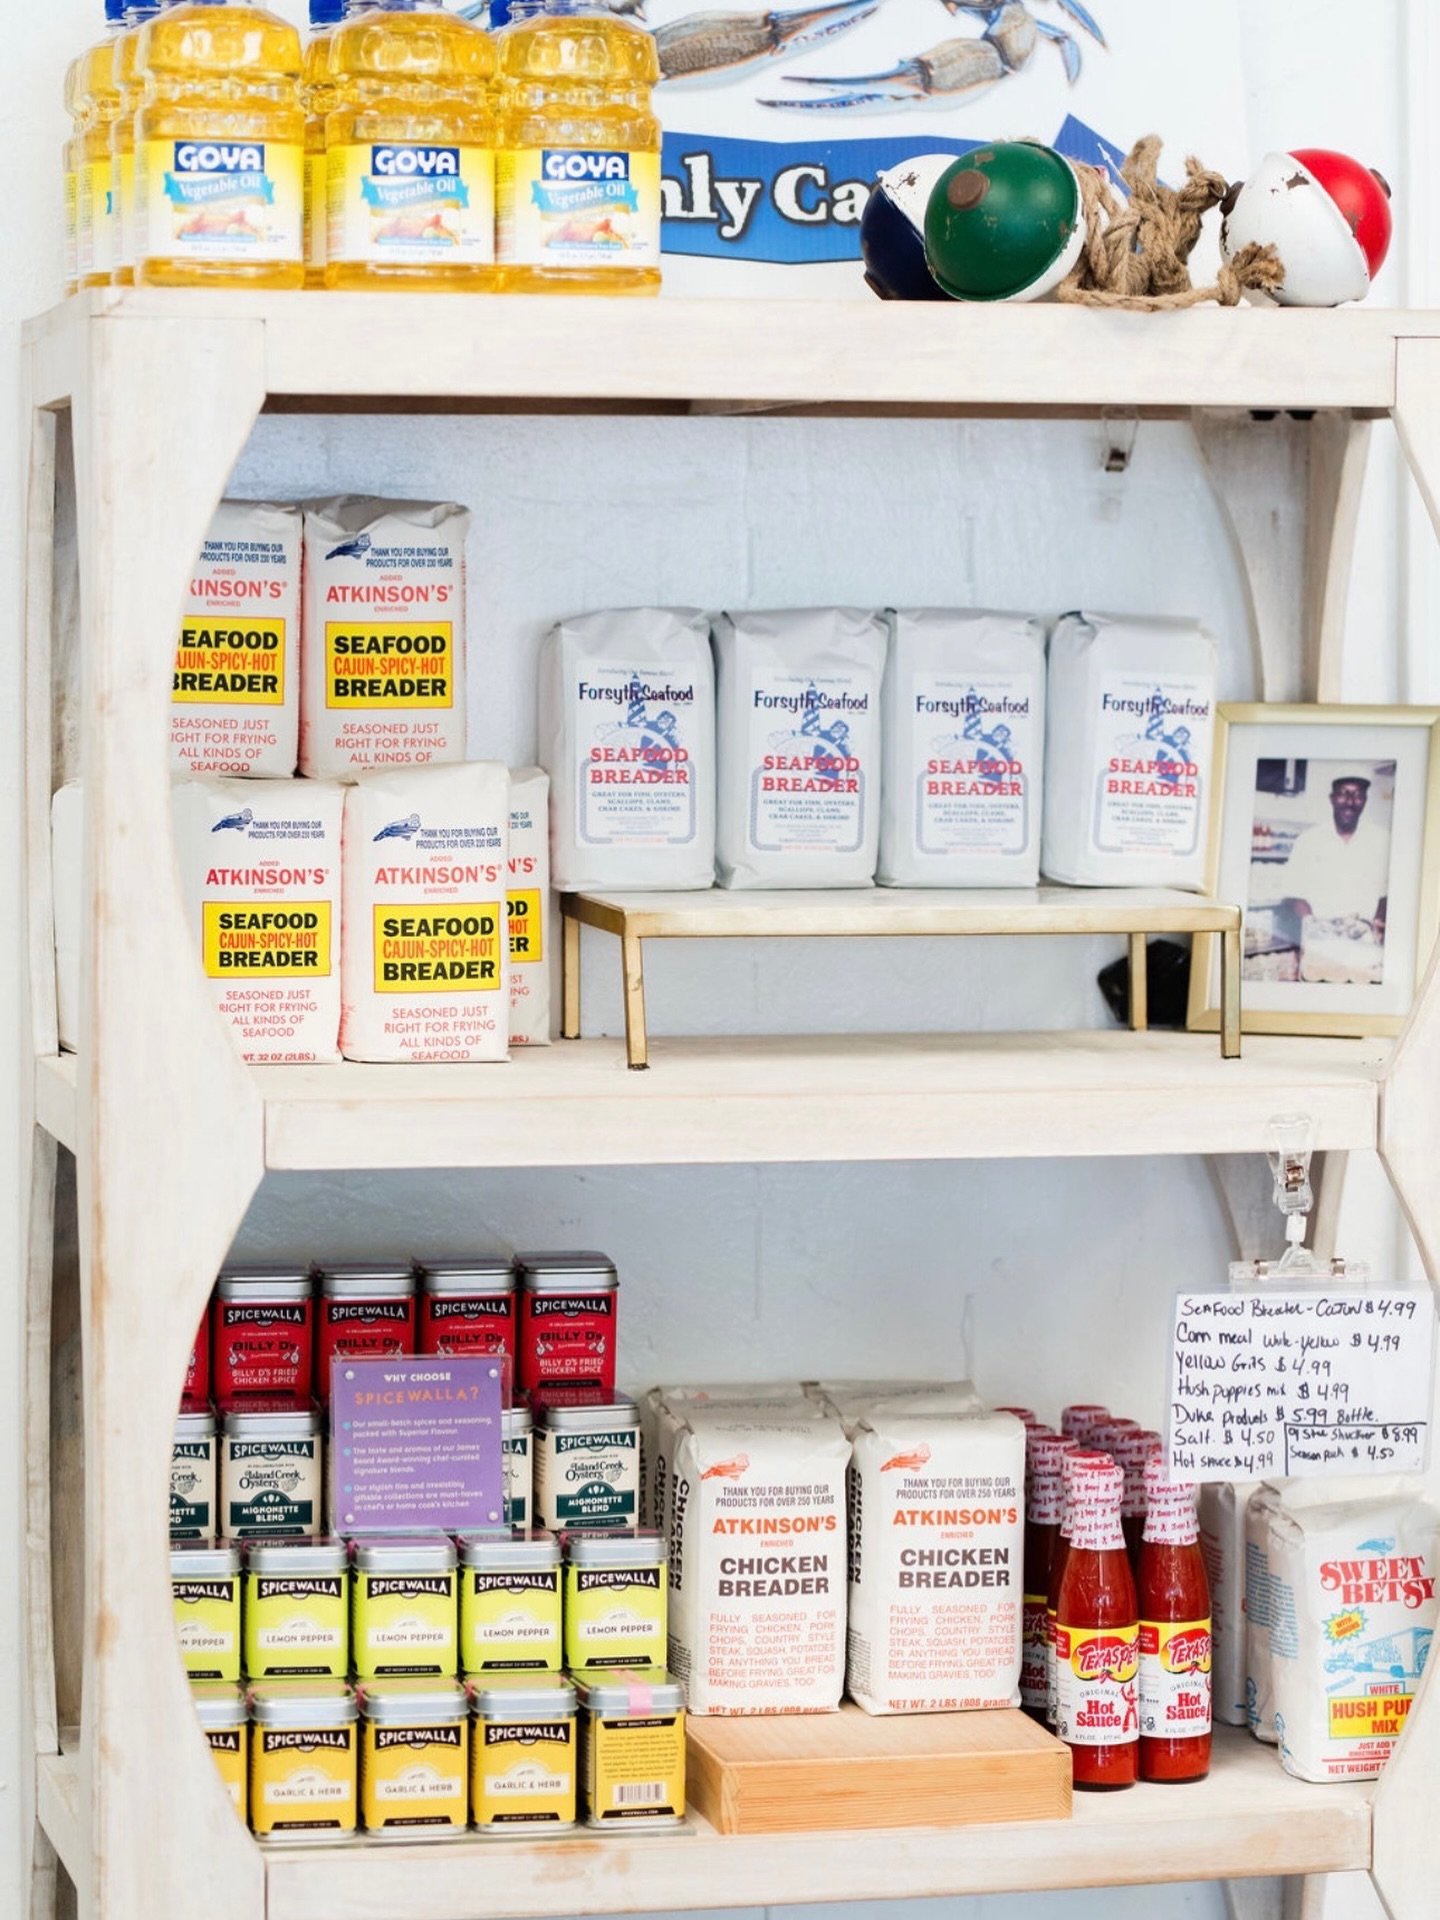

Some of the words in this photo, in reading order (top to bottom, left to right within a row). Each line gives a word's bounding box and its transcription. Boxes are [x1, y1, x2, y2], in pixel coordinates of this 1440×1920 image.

[178, 145, 262, 170] GOYA
[375, 149, 456, 174] GOYA
[545, 154, 627, 178] GOYA
[179, 178, 238, 200] Vegetable
[239, 176, 260, 190] Oil
[377, 183, 434, 203] Vegetable
[436, 180, 456, 194] Oil
[547, 187, 604, 206] Vegetable
[606, 184, 625, 198] Oil
[334, 636, 446, 654] SEAFOOD
[334, 657, 445, 675] CAJUN-SPICY-HOT
[335, 679, 446, 697] BREADER
[578, 682, 641, 704] Forsyth
[642, 684, 694, 701] Seafood
[754, 690, 816, 713] Forsyth
[818, 692, 868, 710] Seafood
[916, 695, 978, 717] Forsyth
[979, 697, 1029, 713] Seafood
[1102, 693, 1162, 716] Forsyth
[1163, 697, 1209, 716] Seafood
[343, 724, 408, 734] SEASONED
[412, 724, 439, 734] JUST
[335, 738, 372, 749] RIGHT
[375, 738, 399, 748] FOR
[402, 738, 446, 748] FRYING
[350, 752, 370, 763] ALL
[374, 752, 412, 763] KINDS
[416, 752, 432, 762] OF
[590, 748, 689, 763] SEAFOOD
[763, 756, 860, 772] SEAFOOD
[928, 759, 1022, 775] SEAFOOD
[1109, 758, 1198, 777] SEAFOOD
[590, 769, 689, 784] BREADER
[762, 778, 858, 793] BREADER
[928, 781, 1023, 796] BREADER
[1108, 780, 1196, 797] BREADER
[219, 913, 318, 930] SEAFOOD
[383, 917, 494, 937] SEAFOOD
[219, 932, 317, 949] CAJUN-SPICY-HOT
[383, 938, 494, 958] CAJUN-SPICY-HOT
[219, 951, 318, 968] BREADER
[384, 961, 494, 981] BREADER
[226, 990, 283, 1000] SEASONED
[286, 989, 311, 999] JUST
[384, 1022, 422, 1033] RIGHT
[425, 1022, 448, 1033] FOR
[451, 1020, 496, 1032] FRYING
[399, 1037, 420, 1048] ALL
[425, 1037, 461, 1047] KINDS
[465, 1036, 481, 1046] OF
[411, 1050, 469, 1060] SEAFOOD
[332, 1306, 405, 1320] SPICEWALLA
[435, 1302, 507, 1317] SPICEWALLA
[535, 1300, 608, 1314] SPICEWALLA
[228, 1309, 301, 1323] SPICEWALLA
[1219, 1328, 1252, 1344] meal
[540, 1358, 561, 1367] BILLY
[580, 1358, 604, 1367] FRIED
[541, 1366, 576, 1374] CHICKEN
[579, 1365, 602, 1374] SPICE
[384, 1374, 407, 1382] WHY
[410, 1372, 451, 1381] CHOOSE
[355, 1386, 481, 1406] SPICEWALLA?
[561, 1433, 632, 1450] SPICEWALLA
[234, 1443, 309, 1458] SPICEWALLA
[600, 1460, 628, 1471] Creek
[275, 1469, 305, 1481] Creek
[565, 1470, 604, 1481] Oysters
[239, 1478, 279, 1489] Oysters
[723, 1486, 749, 1496] THANK
[751, 1486, 766, 1496] YOU
[768, 1486, 783, 1496] FOR
[785, 1485, 812, 1496] BUYING
[814, 1485, 829, 1495] OUR
[896, 1489, 937, 1499] PRODUCTS
[940, 1489, 954, 1499] FOR
[957, 1488, 977, 1499] OVER
[993, 1487, 1016, 1498] YEARS
[568, 1496, 622, 1506] MIGNONETTE
[242, 1506, 299, 1514] MIGNONETTE
[582, 1505, 609, 1513] BLEND
[256, 1514, 285, 1522] BLEND
[713, 1515, 836, 1534] ATKINSON'S
[893, 1508, 1017, 1526] ATKINSON'S
[675, 1479, 690, 1591] CHICKEN
[720, 1555, 828, 1575] CHICKEN
[900, 1548, 1009, 1567] CHICKEN
[581, 1572, 656, 1588] SPICEWALLA
[899, 1570, 1010, 1588] BREADER
[1320, 1556, 1425, 1590] SWEET
[261, 1580, 338, 1595] SPICEWALLA
[371, 1579, 448, 1594] SPICEWALLA
[479, 1575, 554, 1590] SPICEWALLA
[719, 1577, 829, 1597] BREADER
[1342, 1578, 1437, 1609] BETSY
[890, 1605, 921, 1614] FULLY
[932, 1604, 988, 1613] SEASONED
[998, 1603, 1015, 1611] FOR
[484, 1629, 514, 1637] LEMON
[517, 1628, 550, 1637] PEPPER
[587, 1626, 618, 1635] LEMON
[620, 1624, 653, 1633] PEPPER
[266, 1634, 298, 1643] LEMON
[300, 1634, 333, 1643] PEPPER
[376, 1634, 407, 1642] LEMON
[410, 1633, 444, 1642] PEPPER
[1370, 1685, 1400, 1695] WHITE
[1178, 1693, 1201, 1706] Hot
[1087, 1700, 1115, 1715] Hot
[1166, 1705, 1206, 1720] Sauce
[1332, 1701, 1377, 1719] HUSH
[1076, 1712, 1121, 1728] Sauce
[1371, 1719, 1399, 1733] MIX
[379, 1729, 456, 1746] SPICEWALLA
[489, 1726, 566, 1741] SPICEWALLA
[267, 1734, 346, 1749] SPICEWALLA
[1328, 1765, 1345, 1774] NET
[1347, 1763, 1380, 1773] WEIGHT
[274, 1787, 305, 1797] GARLIC
[318, 1787, 342, 1796] HERB
[494, 1781, 526, 1790] GARLIC
[538, 1780, 561, 1789] HERB
